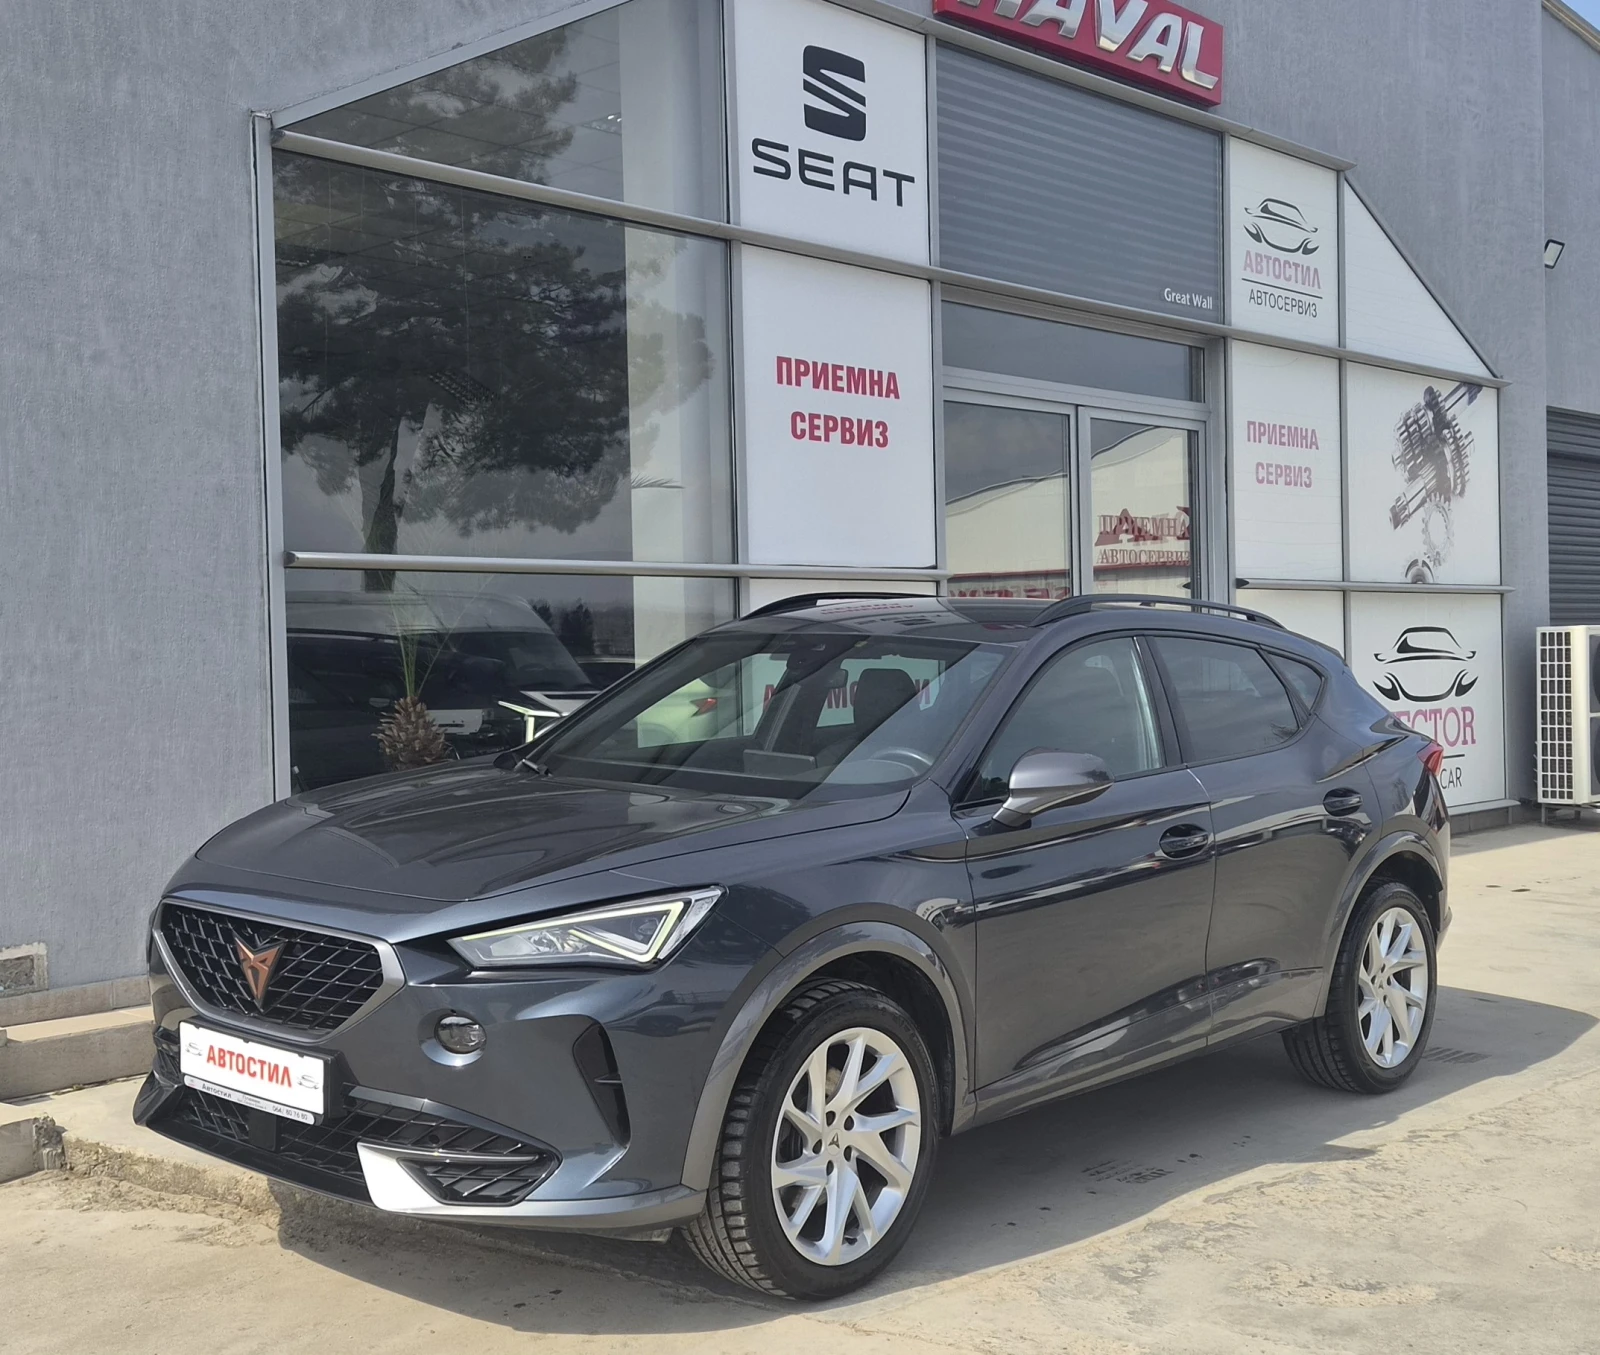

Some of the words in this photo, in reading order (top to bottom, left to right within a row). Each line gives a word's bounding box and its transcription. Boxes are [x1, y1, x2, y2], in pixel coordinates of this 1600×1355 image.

[958, 0, 1219, 90] AVAL
[751, 137, 915, 207] SEAT
[1243, 249, 1321, 290] АВТОСТИЛ
[1163, 287, 1190, 305] Great
[1192, 292, 1213, 310] Wall
[1248, 289, 1318, 318] АВТОСЕРВИЗ
[776, 355, 900, 400] ПРИЕМНА
[790, 411, 889, 449] СЕРВИЗ
[1246, 420, 1320, 451] ПРИЕМНА
[1255, 461, 1312, 489] СЕРВИЗ
[1098, 514, 1190, 538] ПРИЕМНА
[1099, 548, 1191, 565] АВТОСЕРВИЗ
[1440, 767, 1462, 789] CAR
[206, 1044, 292, 1089] АВТОСТИЛ
